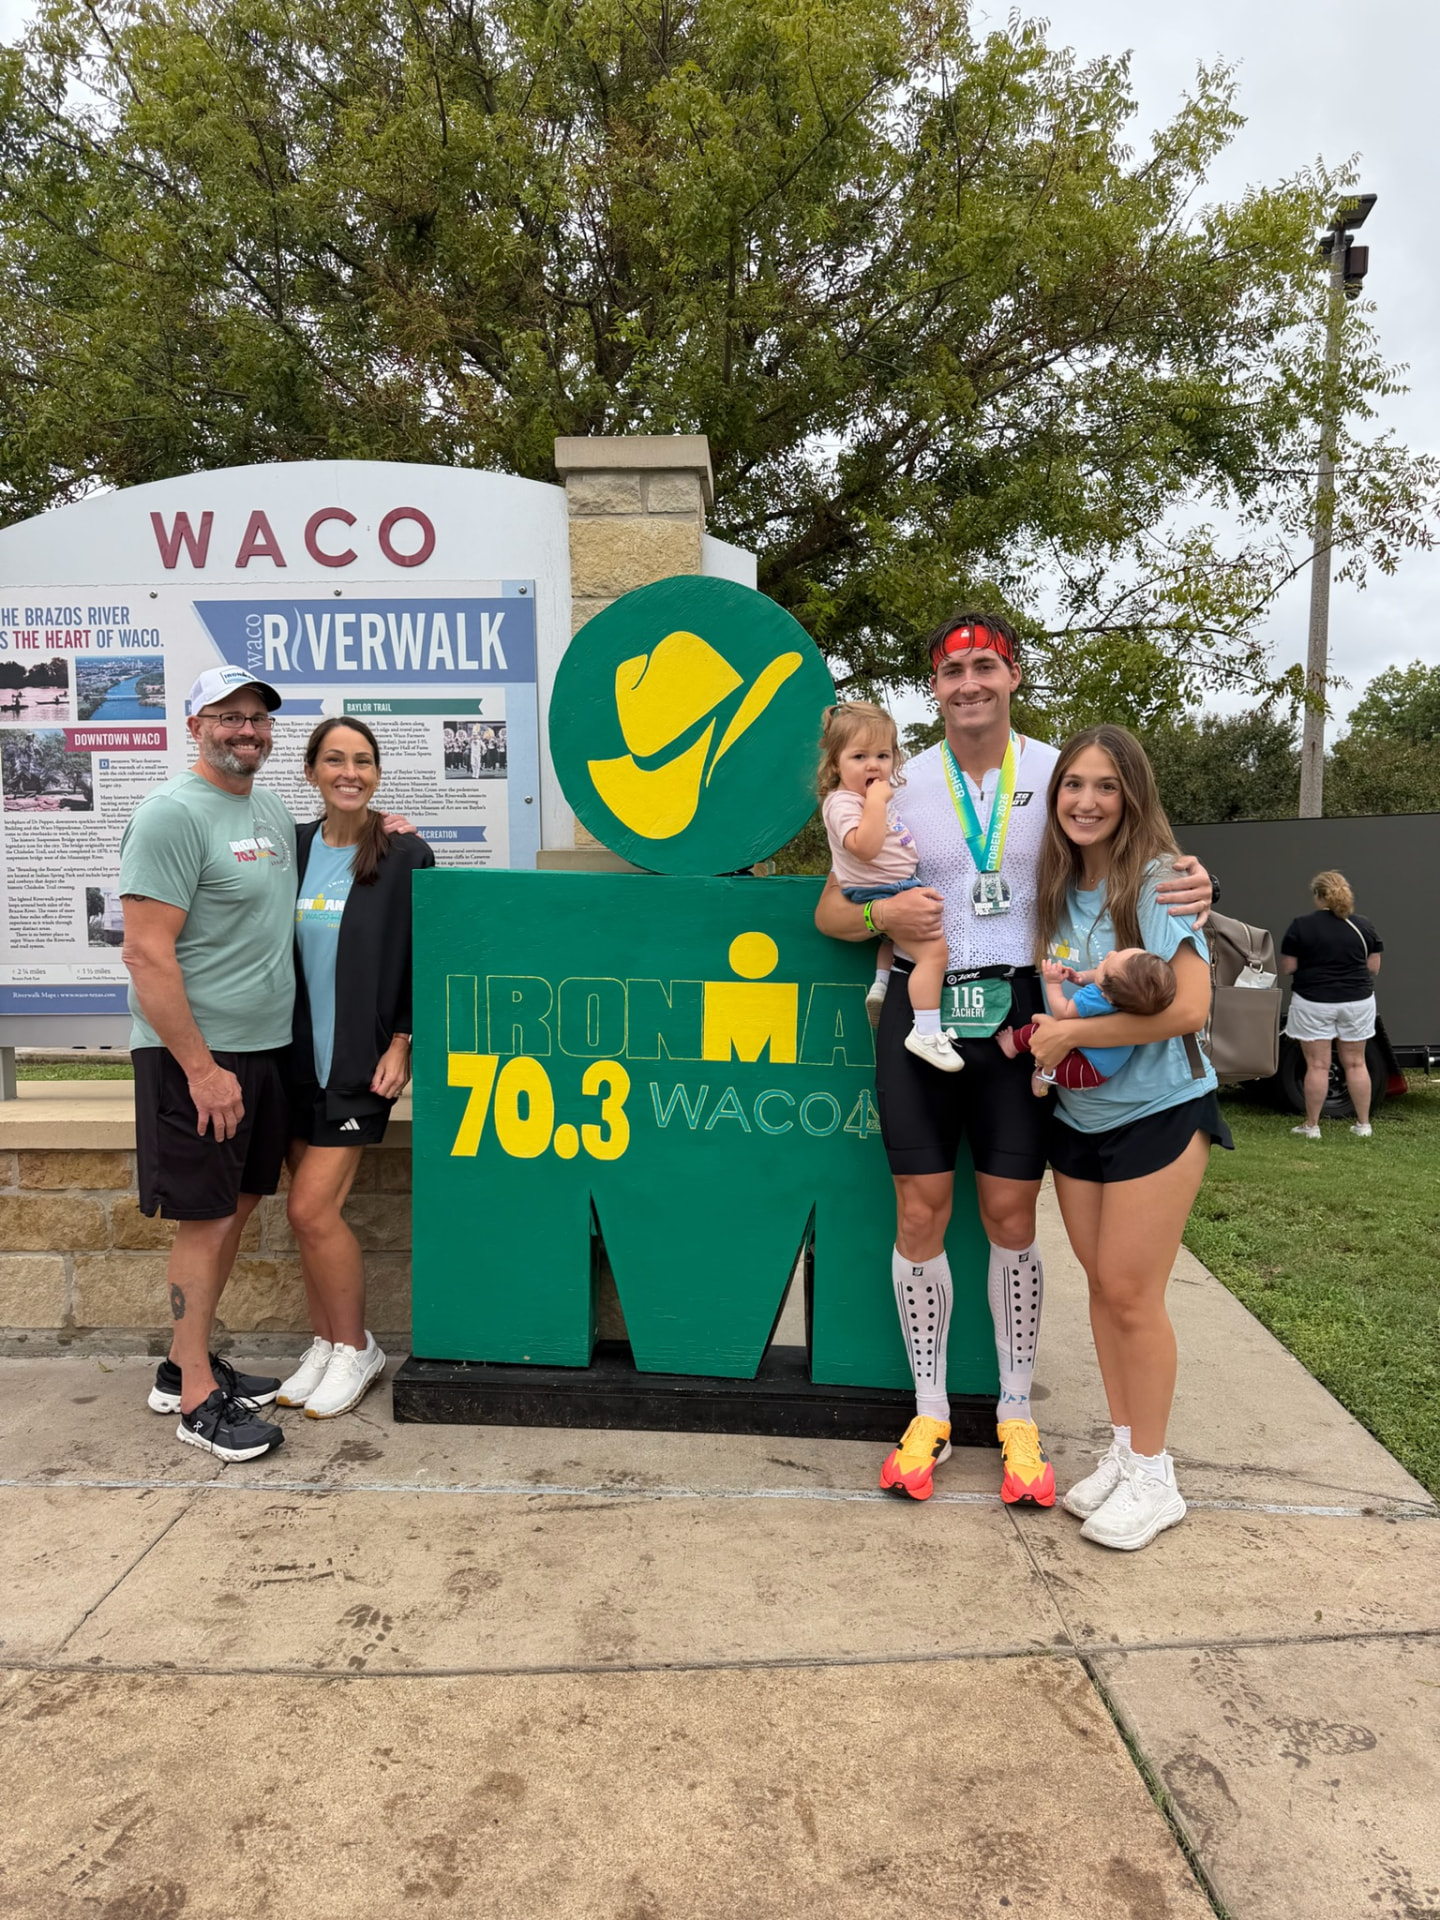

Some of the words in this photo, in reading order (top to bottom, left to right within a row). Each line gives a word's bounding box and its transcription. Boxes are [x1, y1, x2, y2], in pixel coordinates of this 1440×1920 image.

[149, 506, 436, 569] WACO
[1, 608, 19, 626] HE
[25, 607, 83, 626] BRAZOS
[88, 606, 130, 625] RIVER
[0, 631, 8, 649] S
[13, 630, 40, 649] THE
[45, 630, 91, 649] HEART
[96, 629, 114, 648] OF
[118, 629, 164, 648] WACO.
[245, 613, 263, 670] waco
[263, 606, 508, 672] RIVERWALK
[346, 702, 371, 712] BAYLOR
[373, 702, 392, 712] TRAIL
[74, 733, 130, 745] DOWNTOWN
[133, 732, 160, 745] WACO
[943, 749, 965, 799] FINISHER
[994, 820, 1004, 830] 4,
[986, 832, 1003, 872] CTOBER
[41, 991, 56, 999] Maps
[447, 932, 877, 1067] IRONMA
[951, 986, 984, 1008] 116
[951, 1008, 985, 1018] ZACHERY
[446, 1053, 631, 1161] 70.3
[650, 1081, 841, 1137] WACO
